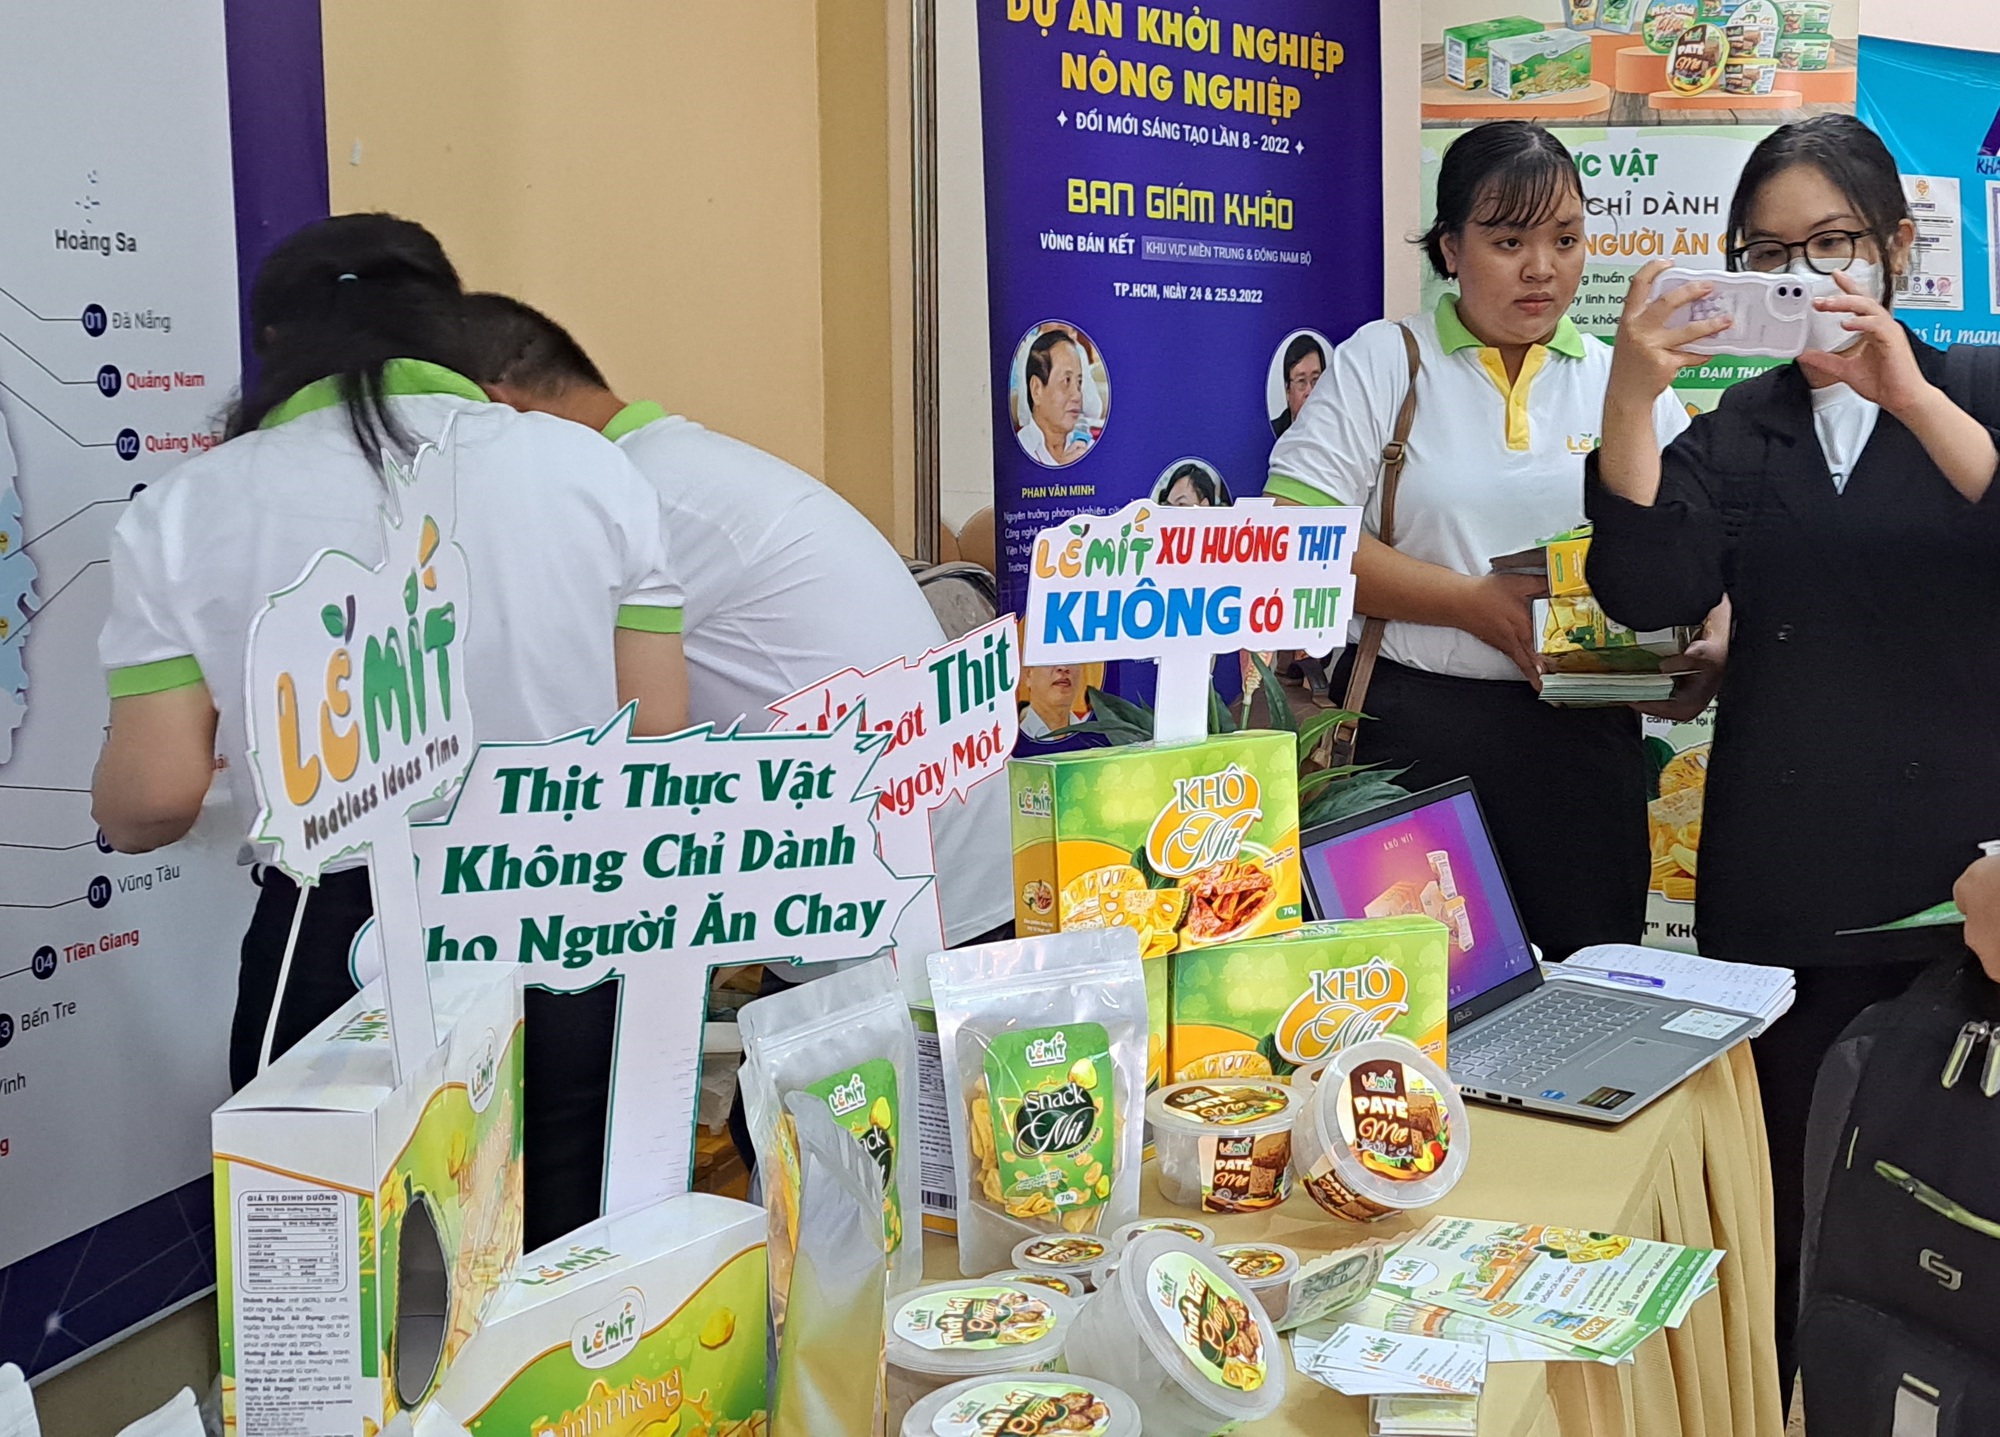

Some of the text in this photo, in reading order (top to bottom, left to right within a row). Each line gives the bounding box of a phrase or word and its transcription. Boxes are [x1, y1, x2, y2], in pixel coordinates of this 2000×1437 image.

[1137, 5, 1221, 54] KHỞI
[1232, 23, 1345, 80] NGHIỆP
[1060, 49, 1302, 126] NÔNG NGHIỆP
[1076, 108, 1103, 132] ĐỔI
[1107, 112, 1139, 136] MỚI
[1142, 116, 1181, 141] SÁNG
[1183, 124, 1209, 148] TẠO
[1212, 124, 1239, 149] LẦN
[1242, 132, 1251, 149] 8
[1261, 134, 1290, 154] 2022
[1609, 148, 1659, 182] VẬT
[1067, 178, 1294, 231] BAN GIÁM KHẢO
[1586, 190, 1719, 216] CHỈ DÀNH
[55, 228, 137, 256] Hoàng Sa
[1040, 230, 1136, 256] VÒNG BÁN KẾT
[1146, 241, 1167, 257] KHU
[1213, 245, 1245, 261] TRUNG
[1247, 248, 1254, 261] &
[1280, 249, 1299, 264] NAM
[1585, 227, 1664, 257] NGƯỜI
[1672, 227, 1708, 256] ĂN
[1113, 282, 1263, 304] TP.HCM, NGÀY 24 & 25.9.2022
[1585, 294, 1605, 304] linh
[85, 312, 101, 330] 01
[112, 312, 132, 330] Đà
[1934, 323, 1953, 343] in
[100, 370, 205, 392] 01 Quảng Nam
[1700, 366, 1734, 382] ĐẠM
[119, 435, 137, 453] 02
[145, 432, 189, 454] Quảng
[1021, 484, 1095, 499] PHAN VĂN MINH
[1156, 526, 1196, 565] XU
[1200, 517, 1290, 564] HƯỚNG
[1297, 525, 1347, 570] THỊT
[1043, 577, 1341, 644] KHÔNG CÓ THỊT
[929, 628, 1014, 725] Thịt
[876, 720, 1004, 821] Ngày Một
[1177, 764, 1245, 811] KHÔ
[303, 733, 460, 850] Meatless Ideas Time
[495, 758, 836, 824] Thịt Thực Vật
[440, 824, 855, 894] Không Chỉ Dành
[90, 864, 180, 902] 01 Vũng Tàu
[424, 891, 887, 971] ho Người Ăn Chay
[35, 928, 139, 972] 04 Tiền Giang
[1315, 957, 1390, 1003] KHÔ
[21, 1007, 49, 1031] Bến
[53, 1002, 77, 1019] Tre
[1026, 1083, 1086, 1111] Snack
[282, 1194, 303, 1202] DINH
[606, 1368, 681, 1426] Phồng
